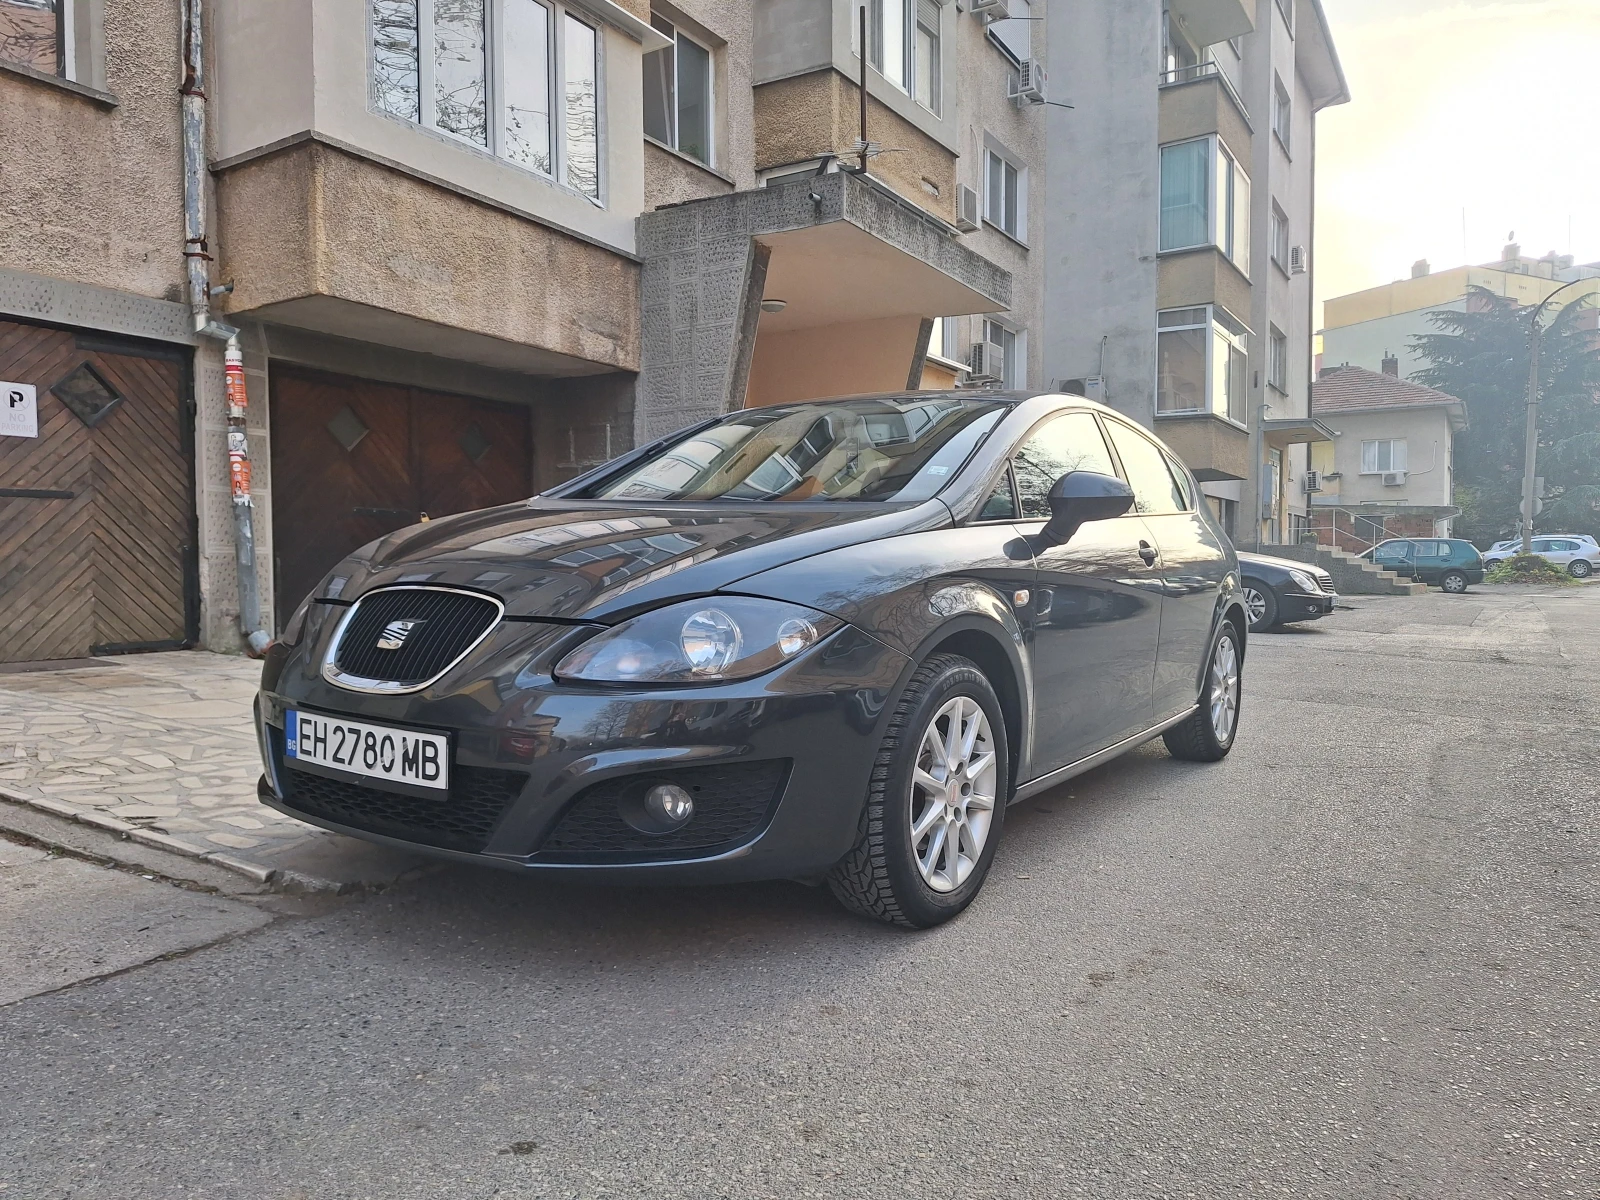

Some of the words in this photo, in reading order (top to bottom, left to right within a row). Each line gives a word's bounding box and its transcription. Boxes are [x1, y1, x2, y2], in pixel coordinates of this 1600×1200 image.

[9, 412, 26, 423] NO
[1, 422, 34, 433] PARKING
[287, 738, 296, 751] BG
